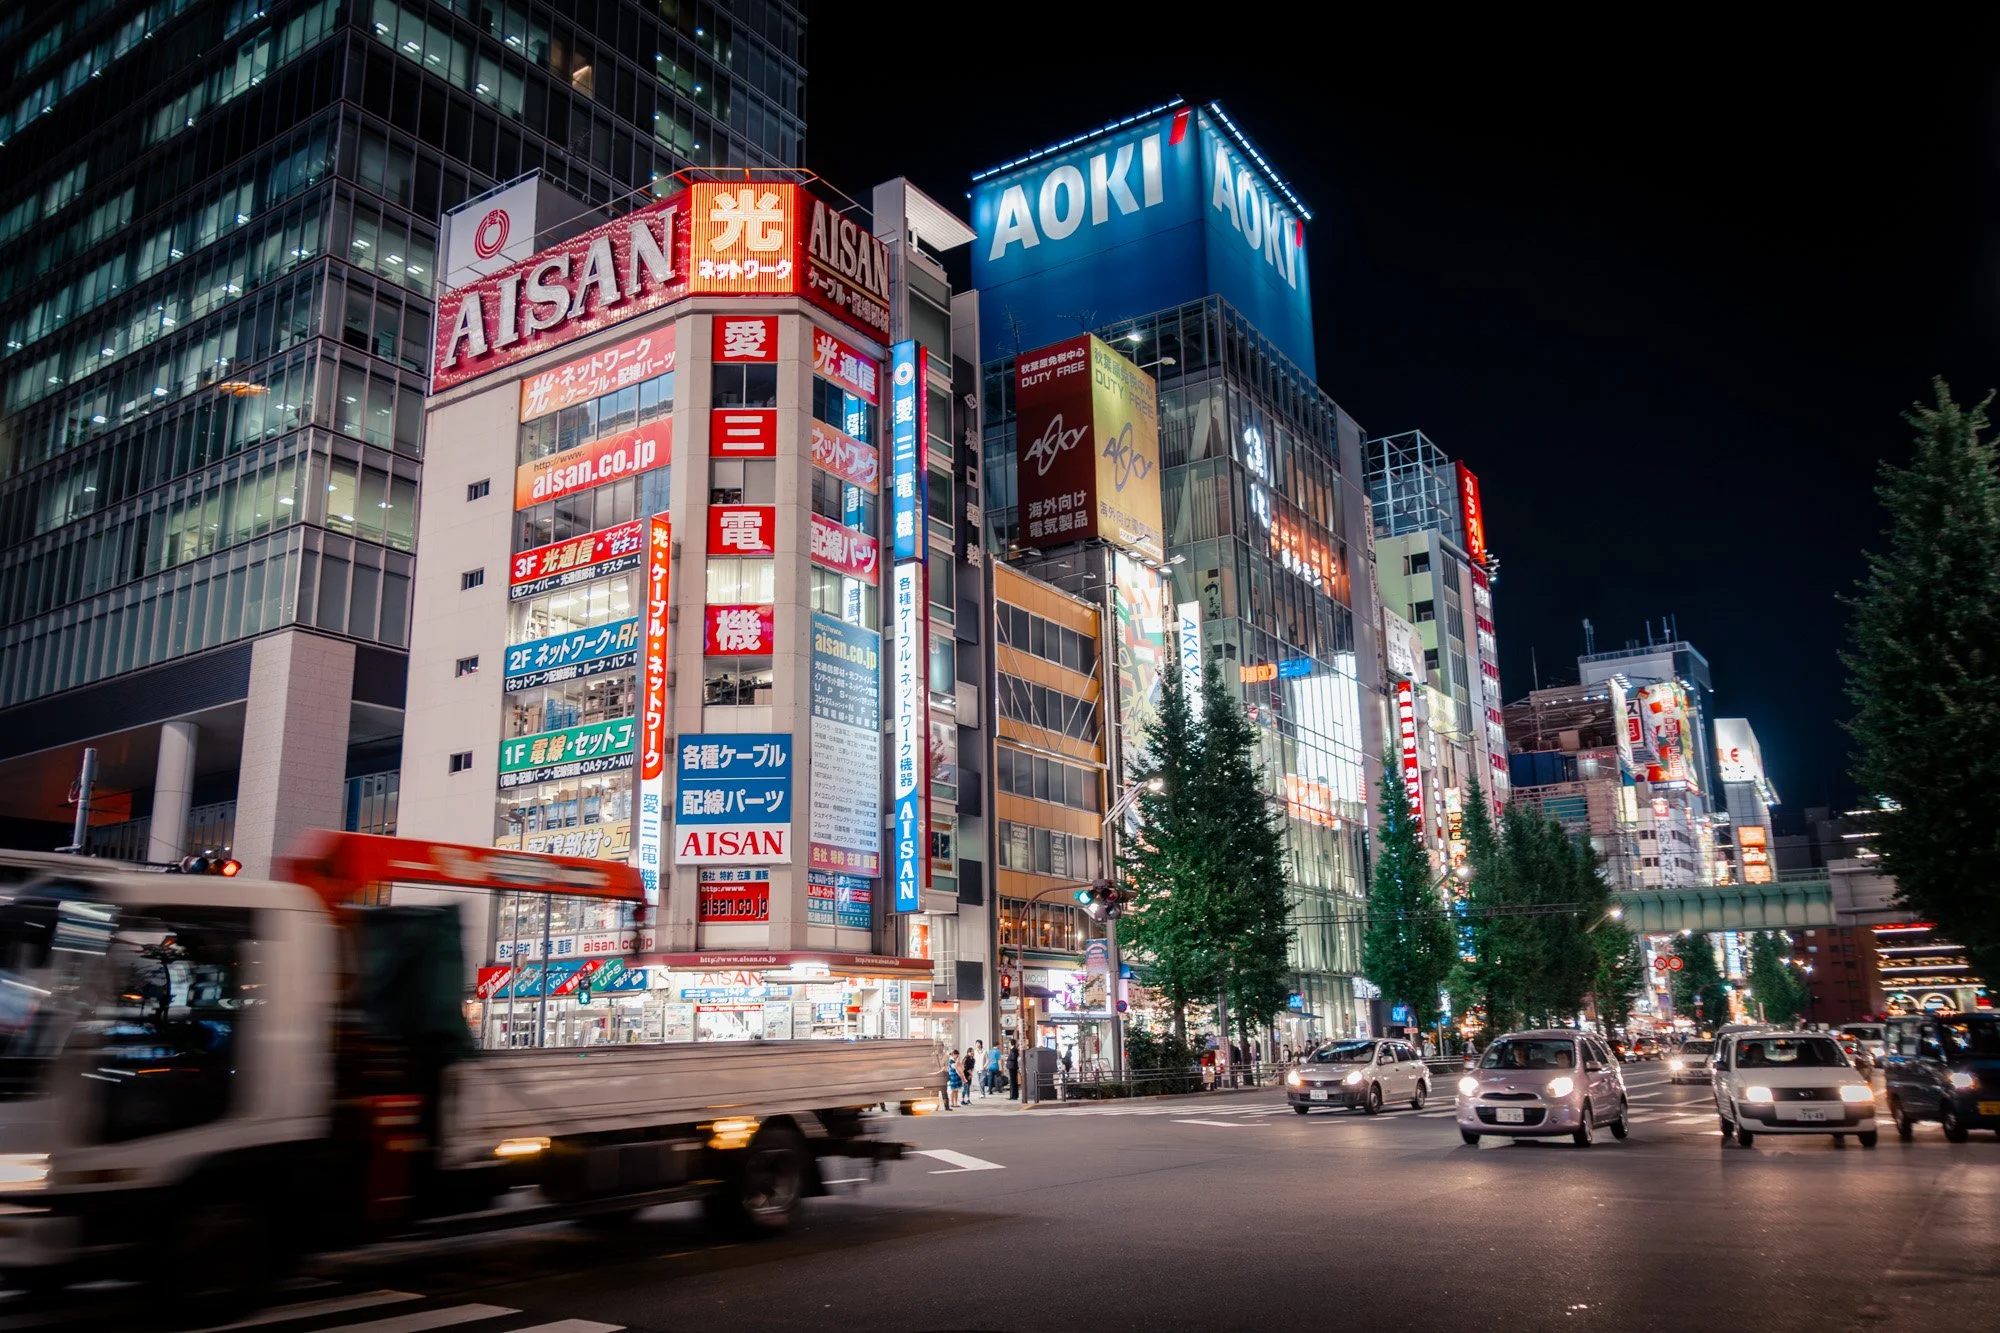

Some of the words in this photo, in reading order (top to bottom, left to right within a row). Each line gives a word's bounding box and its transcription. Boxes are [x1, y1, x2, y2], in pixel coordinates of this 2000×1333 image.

[989, 133, 1163, 261] AOKI
[1213, 146, 1296, 290] AOKI
[711, 190, 785, 252] 光
[699, 259, 791, 281] ネットワーク
[808, 200, 890, 300] AISAN
[441, 205, 679, 368] AISAN
[814, 335, 876, 396] 光通信
[1021, 347, 1086, 373] 秋葉原免税中心
[1021, 370, 1051, 388] DUTY
[1056, 361, 1086, 378] FREE
[525, 373, 555, 418] 光
[1095, 370, 1125, 399] DUTY
[1129, 392, 1154, 419] FREE
[532, 439, 656, 499] aisan.co.jp
[533, 451, 586, 472] http://www.
[811, 427, 878, 483] ネットワーク
[895, 397, 913, 538] 愛三電機
[1029, 489, 1087, 519] 海外向け
[1029, 510, 1088, 538] 電気製品
[604, 522, 642, 542] ネットワーク
[810, 523, 877, 573] 配線パーツ
[515, 555, 537, 578] 3F
[509, 648, 532, 671] 2F
[644, 527, 668, 769] 光・ケーブル・ネットワーク
[814, 633, 877, 671] aisan.co.jp
[1182, 617, 1200, 677] AKKY
[505, 743, 526, 766] 1F
[529, 723, 635, 766] 電線・セットコ
[682, 744, 787, 770] 各種ケーブル
[682, 789, 785, 815] 配線パーツ
[641, 793, 659, 890] 愛三電機
[680, 831, 784, 857] AISAN
[899, 801, 914, 900] AISAN
[702, 892, 769, 919] aisan.co.jp
[599, 964, 622, 987] UPS
